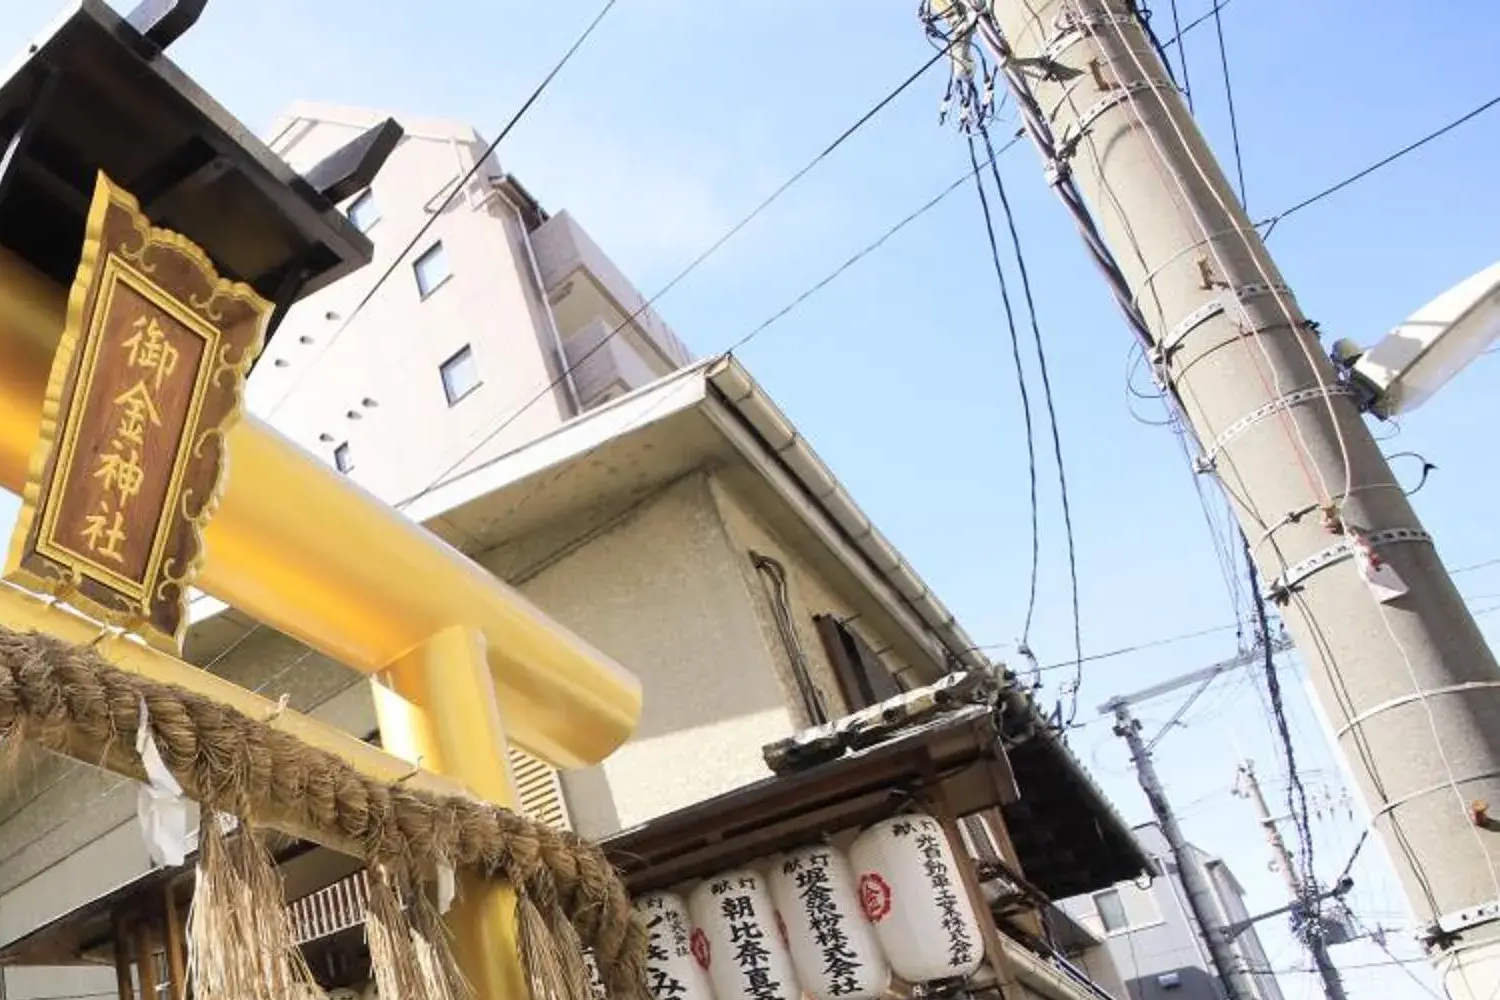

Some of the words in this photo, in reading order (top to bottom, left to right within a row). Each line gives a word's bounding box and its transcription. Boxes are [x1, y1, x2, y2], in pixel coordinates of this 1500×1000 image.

[80, 314, 179, 563] 御金神社
[710, 878, 757, 895] 献灯
